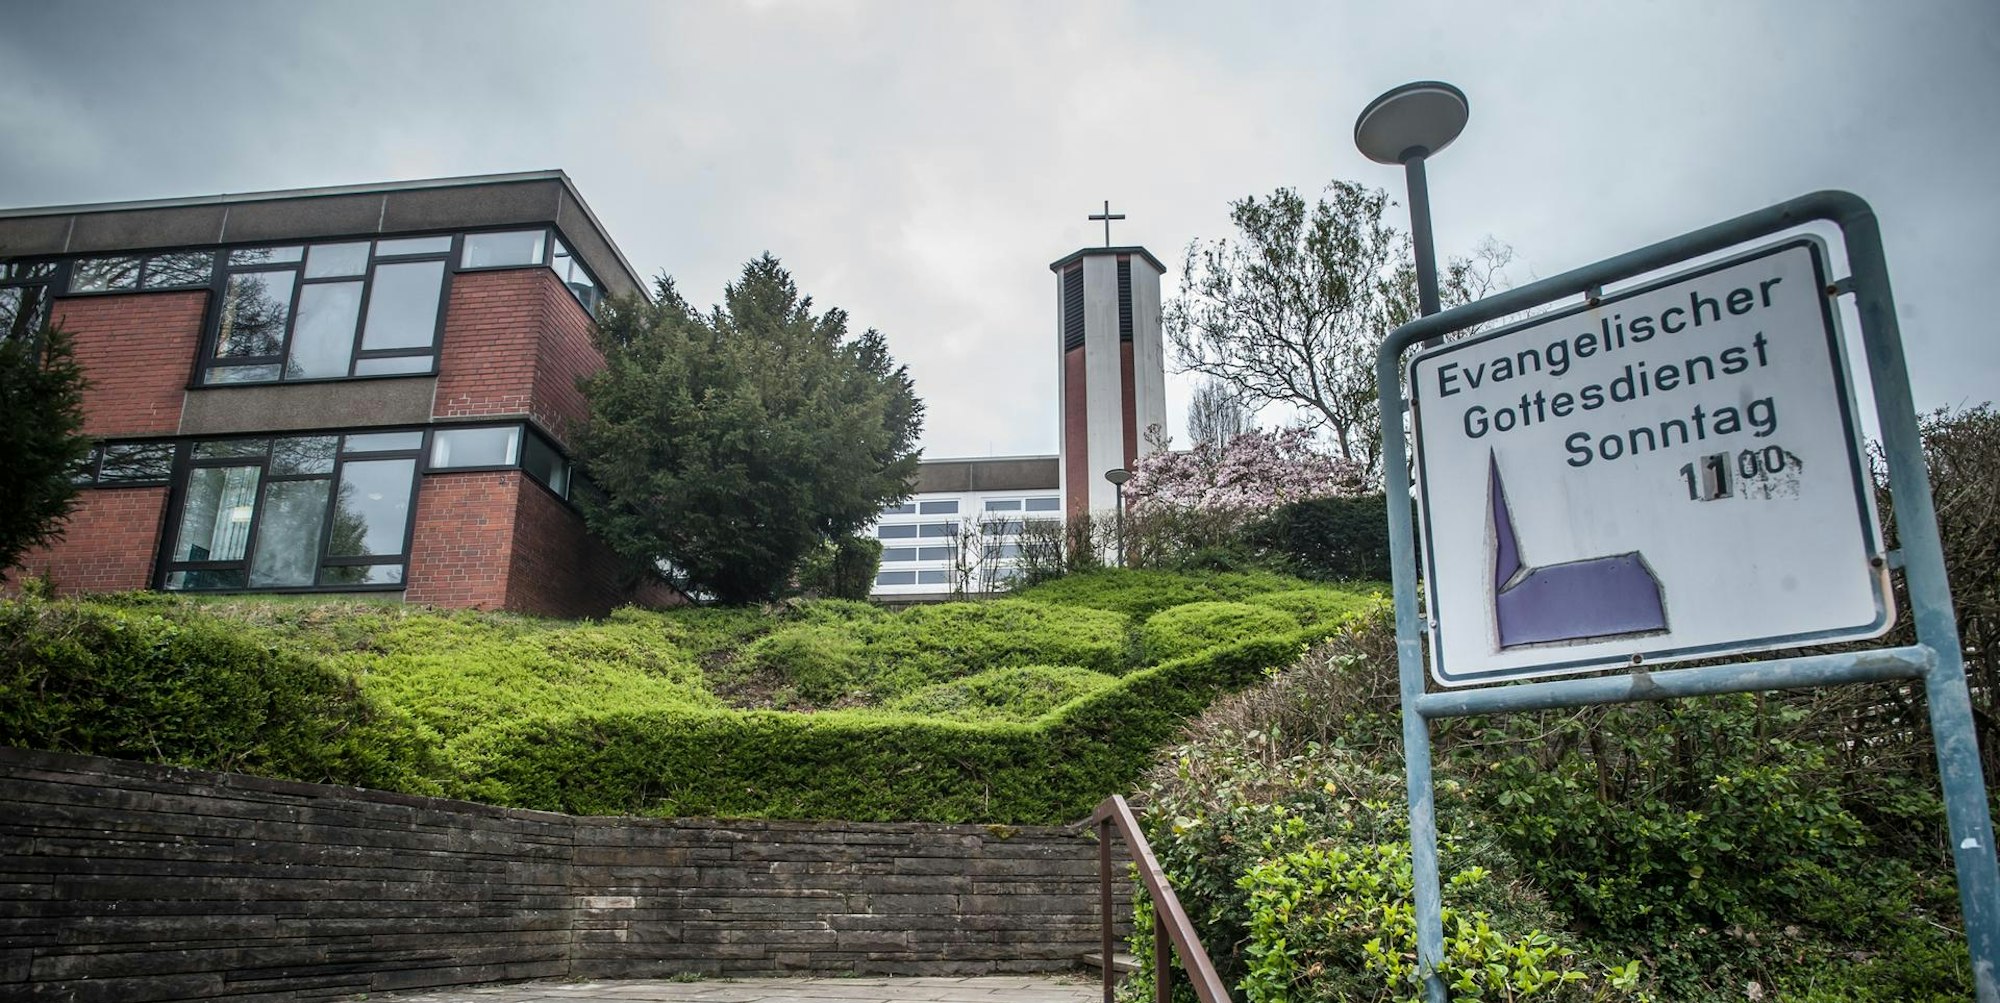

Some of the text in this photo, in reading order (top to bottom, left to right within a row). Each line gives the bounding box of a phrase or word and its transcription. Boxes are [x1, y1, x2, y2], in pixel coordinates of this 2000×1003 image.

[1437, 277, 1783, 398] Evangelischer
[1464, 331, 1769, 439] Gottesdienst
[1565, 396, 1779, 468] Sonntag
